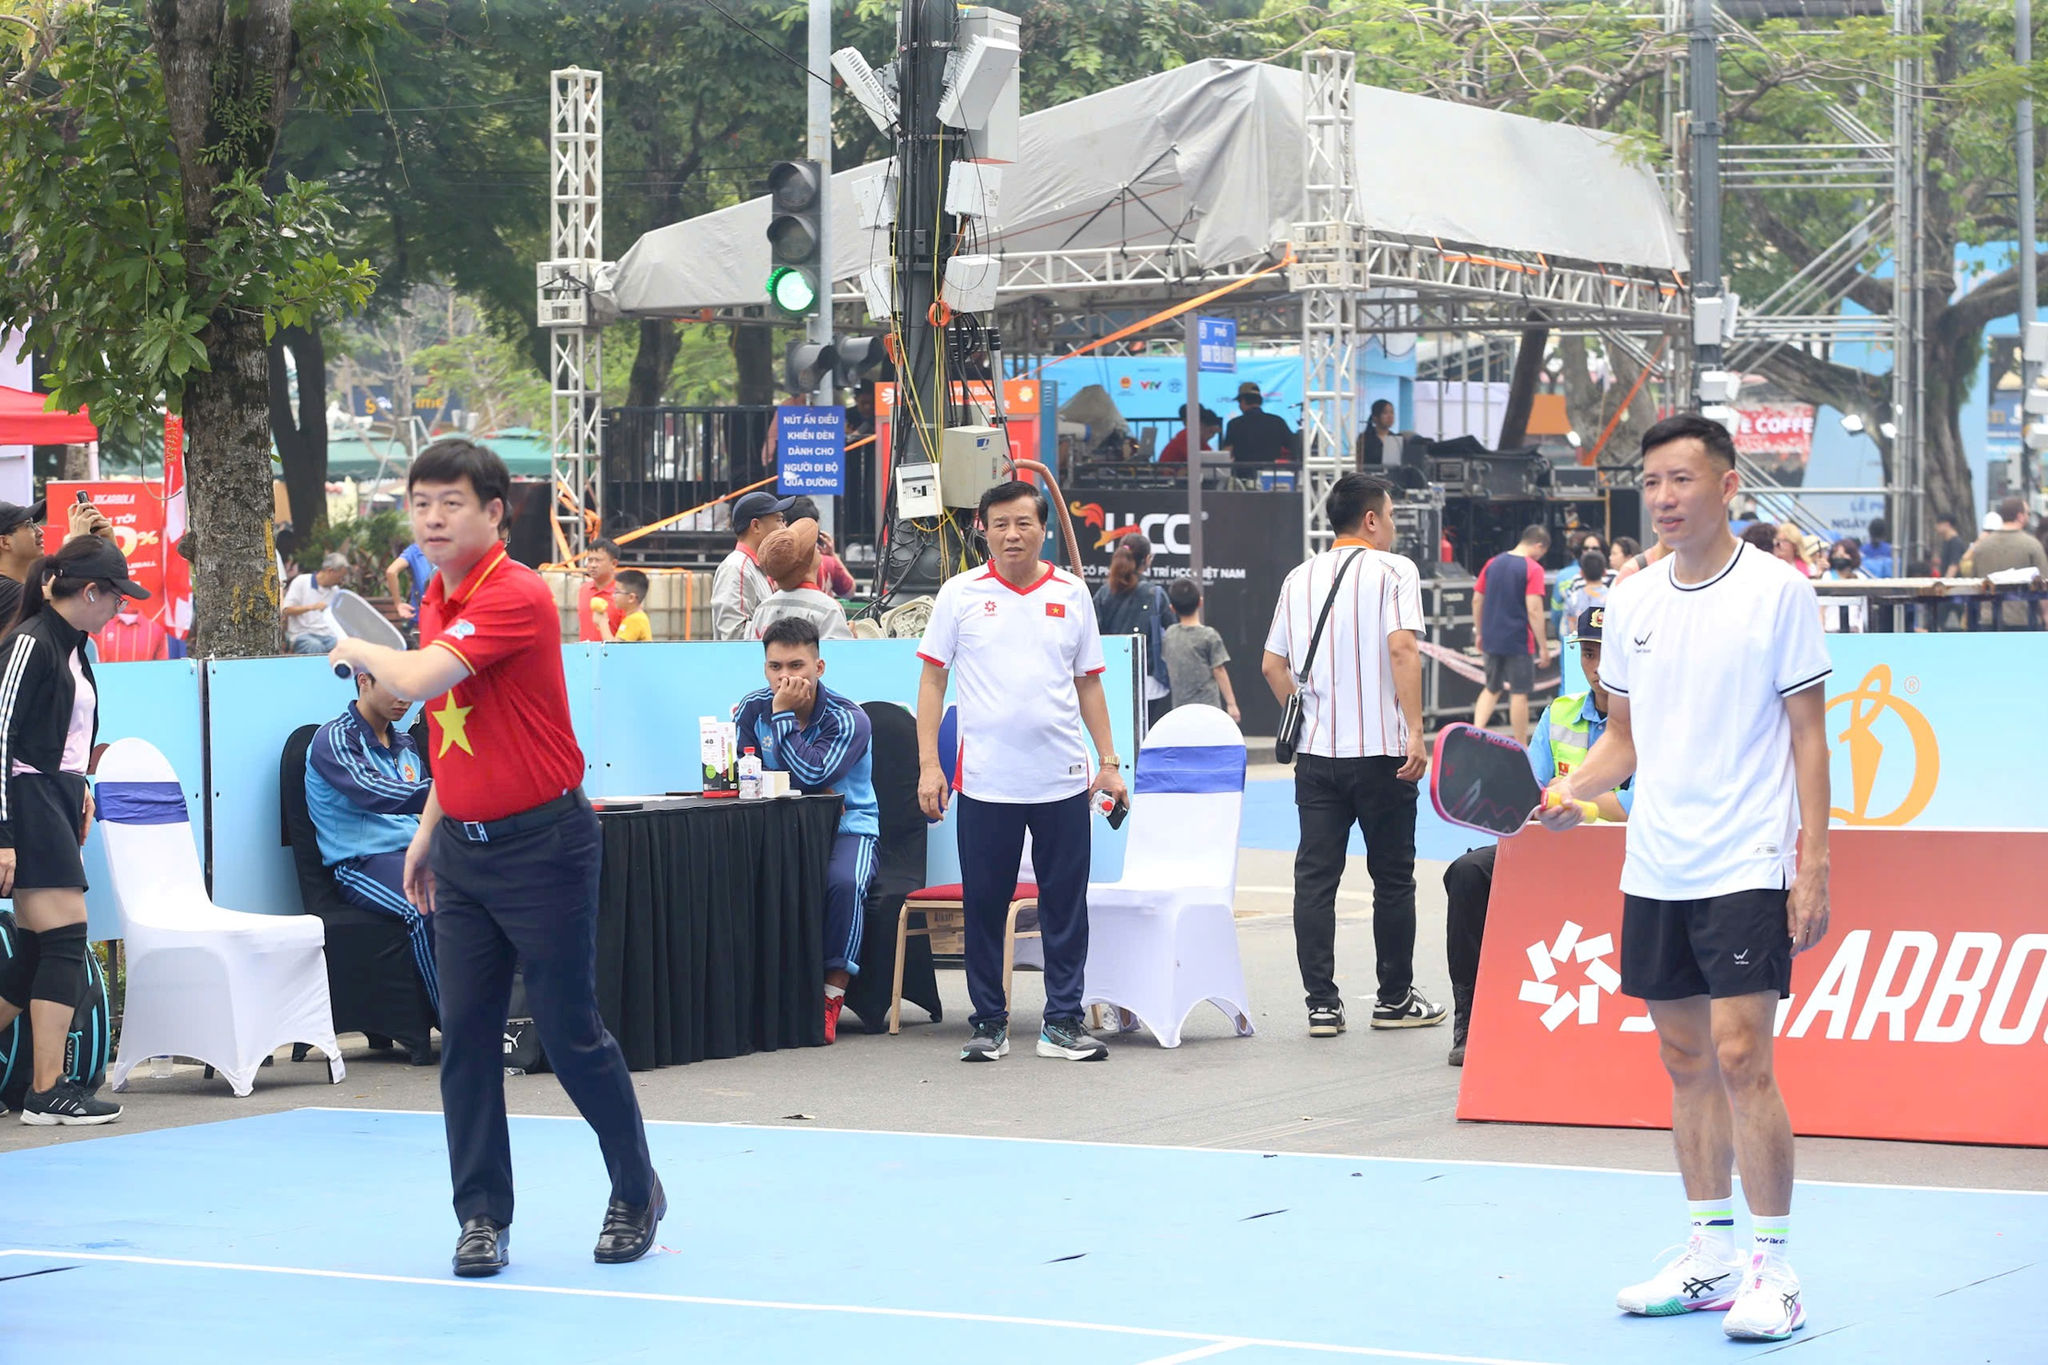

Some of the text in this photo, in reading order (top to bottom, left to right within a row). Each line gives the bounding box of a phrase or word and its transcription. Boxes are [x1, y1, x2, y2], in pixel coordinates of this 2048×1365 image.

[1140, 380, 1162, 390] VTV
[783, 414, 801, 424] NÚT
[788, 445, 834, 456] DÀNH CHO
[814, 464, 823, 472] ĐI
[825, 462, 839, 474] BỘ
[784, 477, 838, 487] QUA ĐƯỜNG
[1220, 568, 1246, 579] NAM
